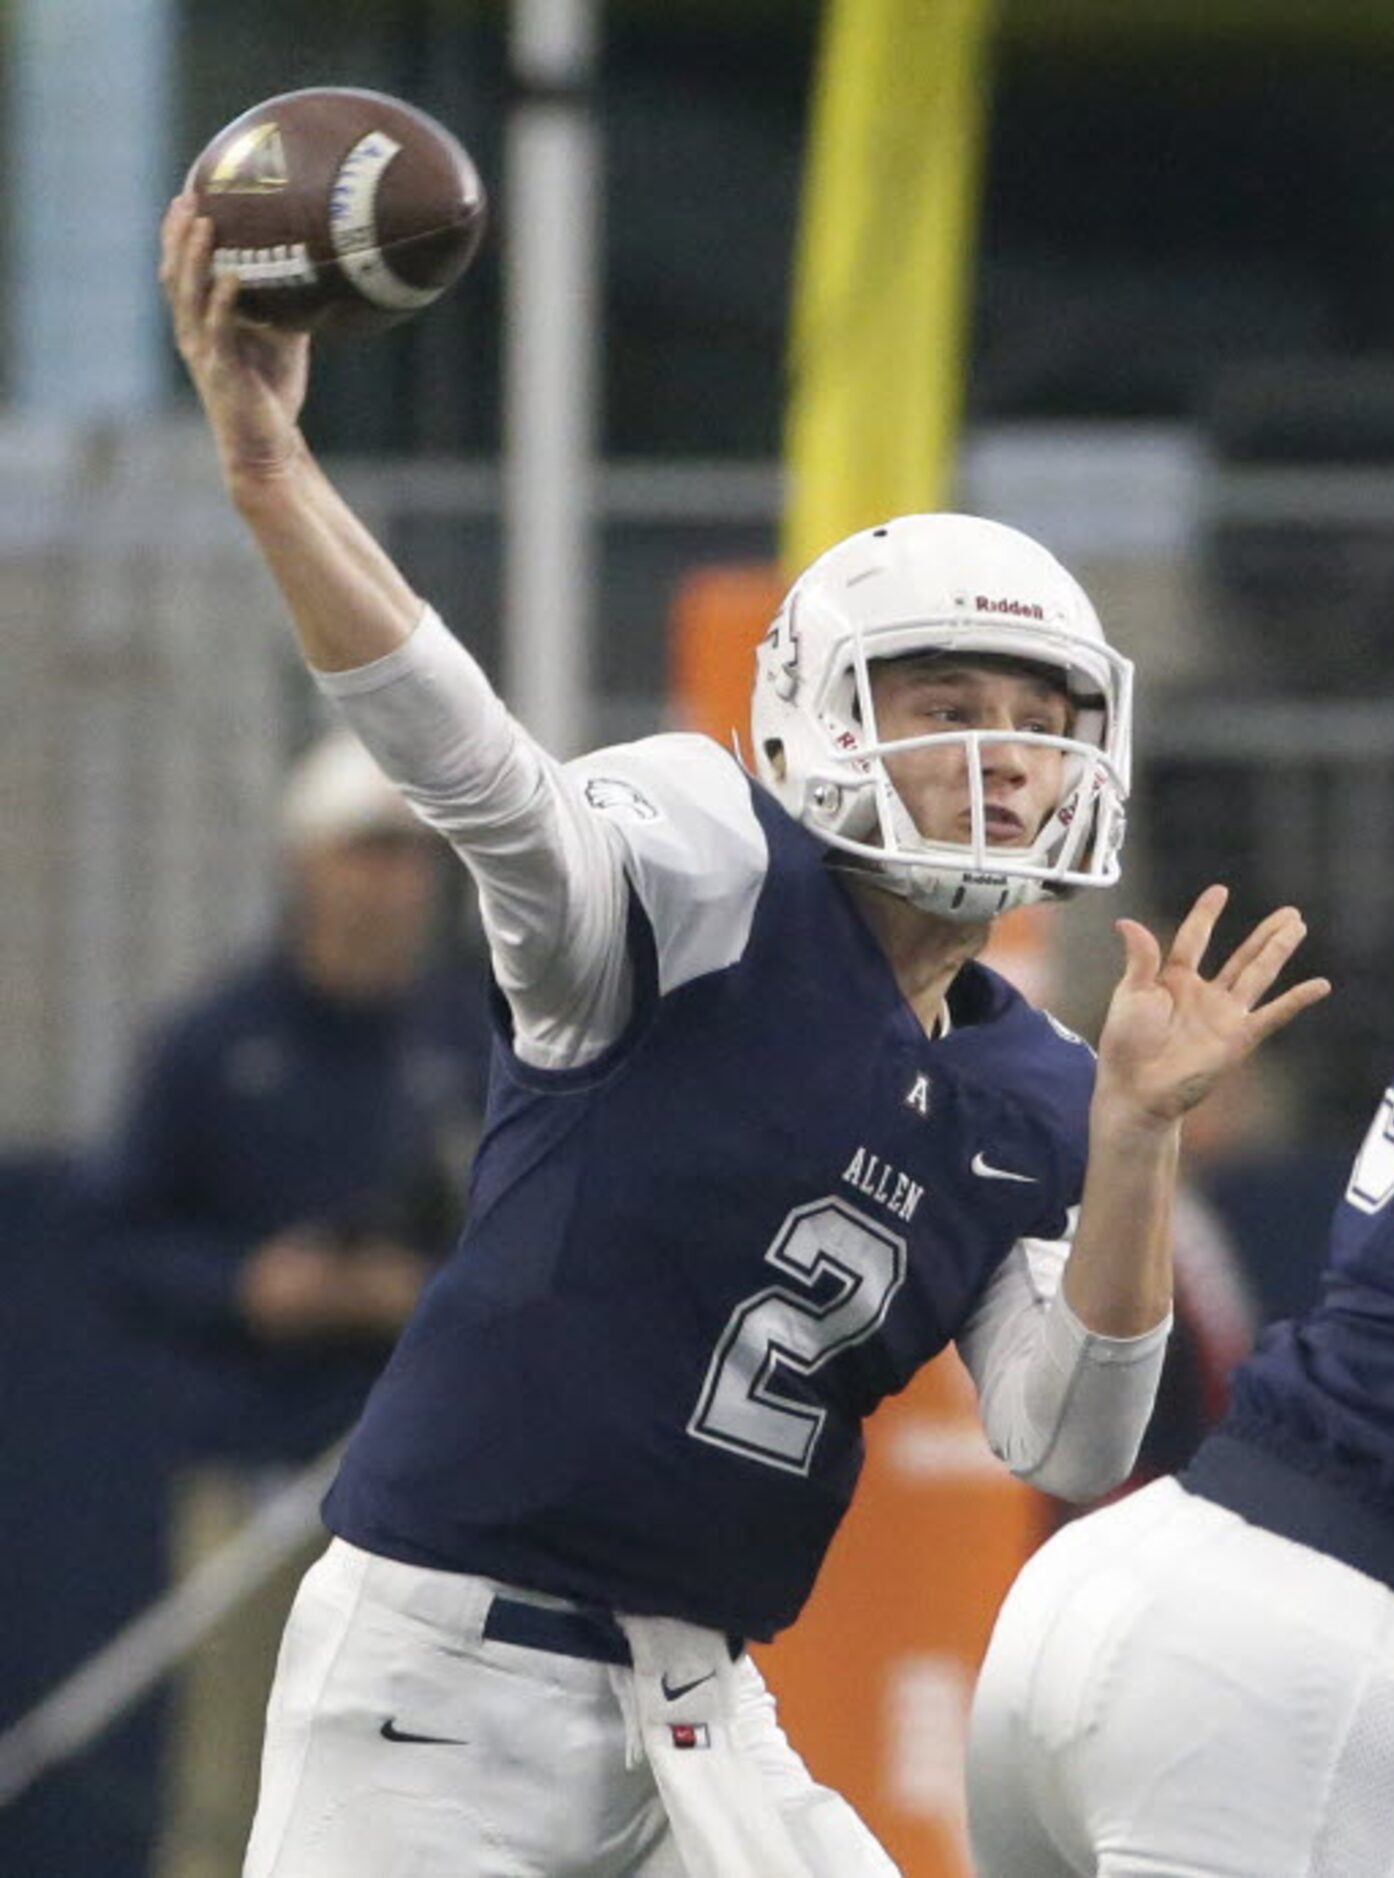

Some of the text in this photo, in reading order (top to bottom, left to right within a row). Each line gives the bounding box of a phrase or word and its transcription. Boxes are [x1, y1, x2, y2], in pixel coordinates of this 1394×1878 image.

[975, 595, 1044, 621] Riddell
[907, 1074, 931, 1115] A
[841, 1145, 926, 1223] ALLEN
[686, 1194, 909, 1478] 2
